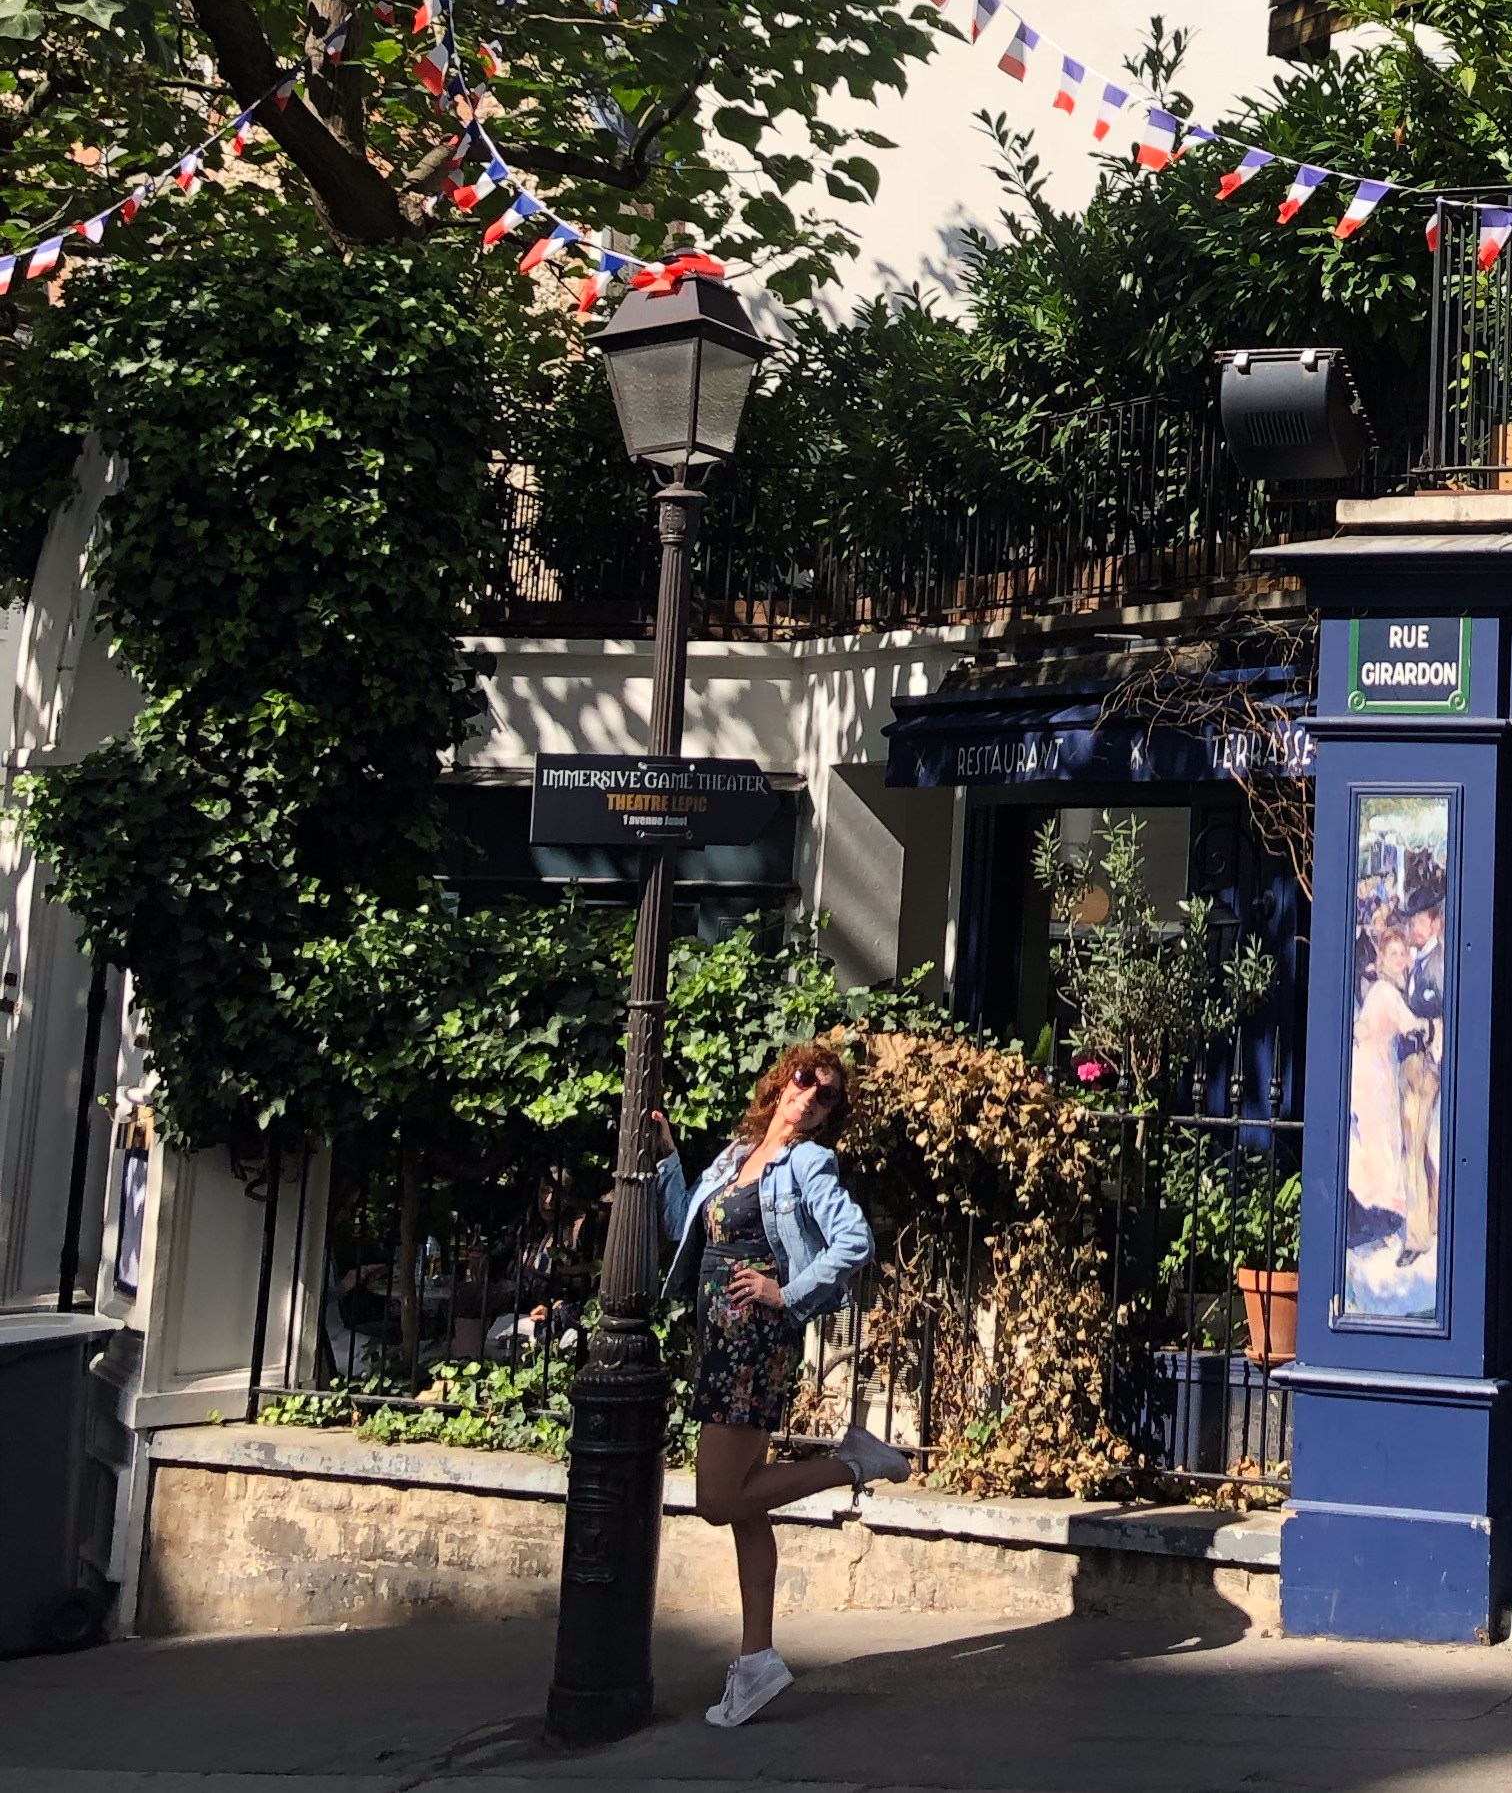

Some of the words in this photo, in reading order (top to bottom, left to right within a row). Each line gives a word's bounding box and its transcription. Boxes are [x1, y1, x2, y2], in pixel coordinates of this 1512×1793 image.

[1389, 624, 1430, 649] RUE
[1361, 661, 1457, 686] GIRARDON
[957, 737, 1064, 777] RESTAURANT
[1212, 729, 1313, 769] TERRASSE
[541, 768, 641, 791] IMMERSIVE
[644, 771, 693, 790] GAME
[697, 772, 768, 794] THEATER
[606, 793, 669, 812] THEATRE
[671, 795, 708, 812] LEPIC
